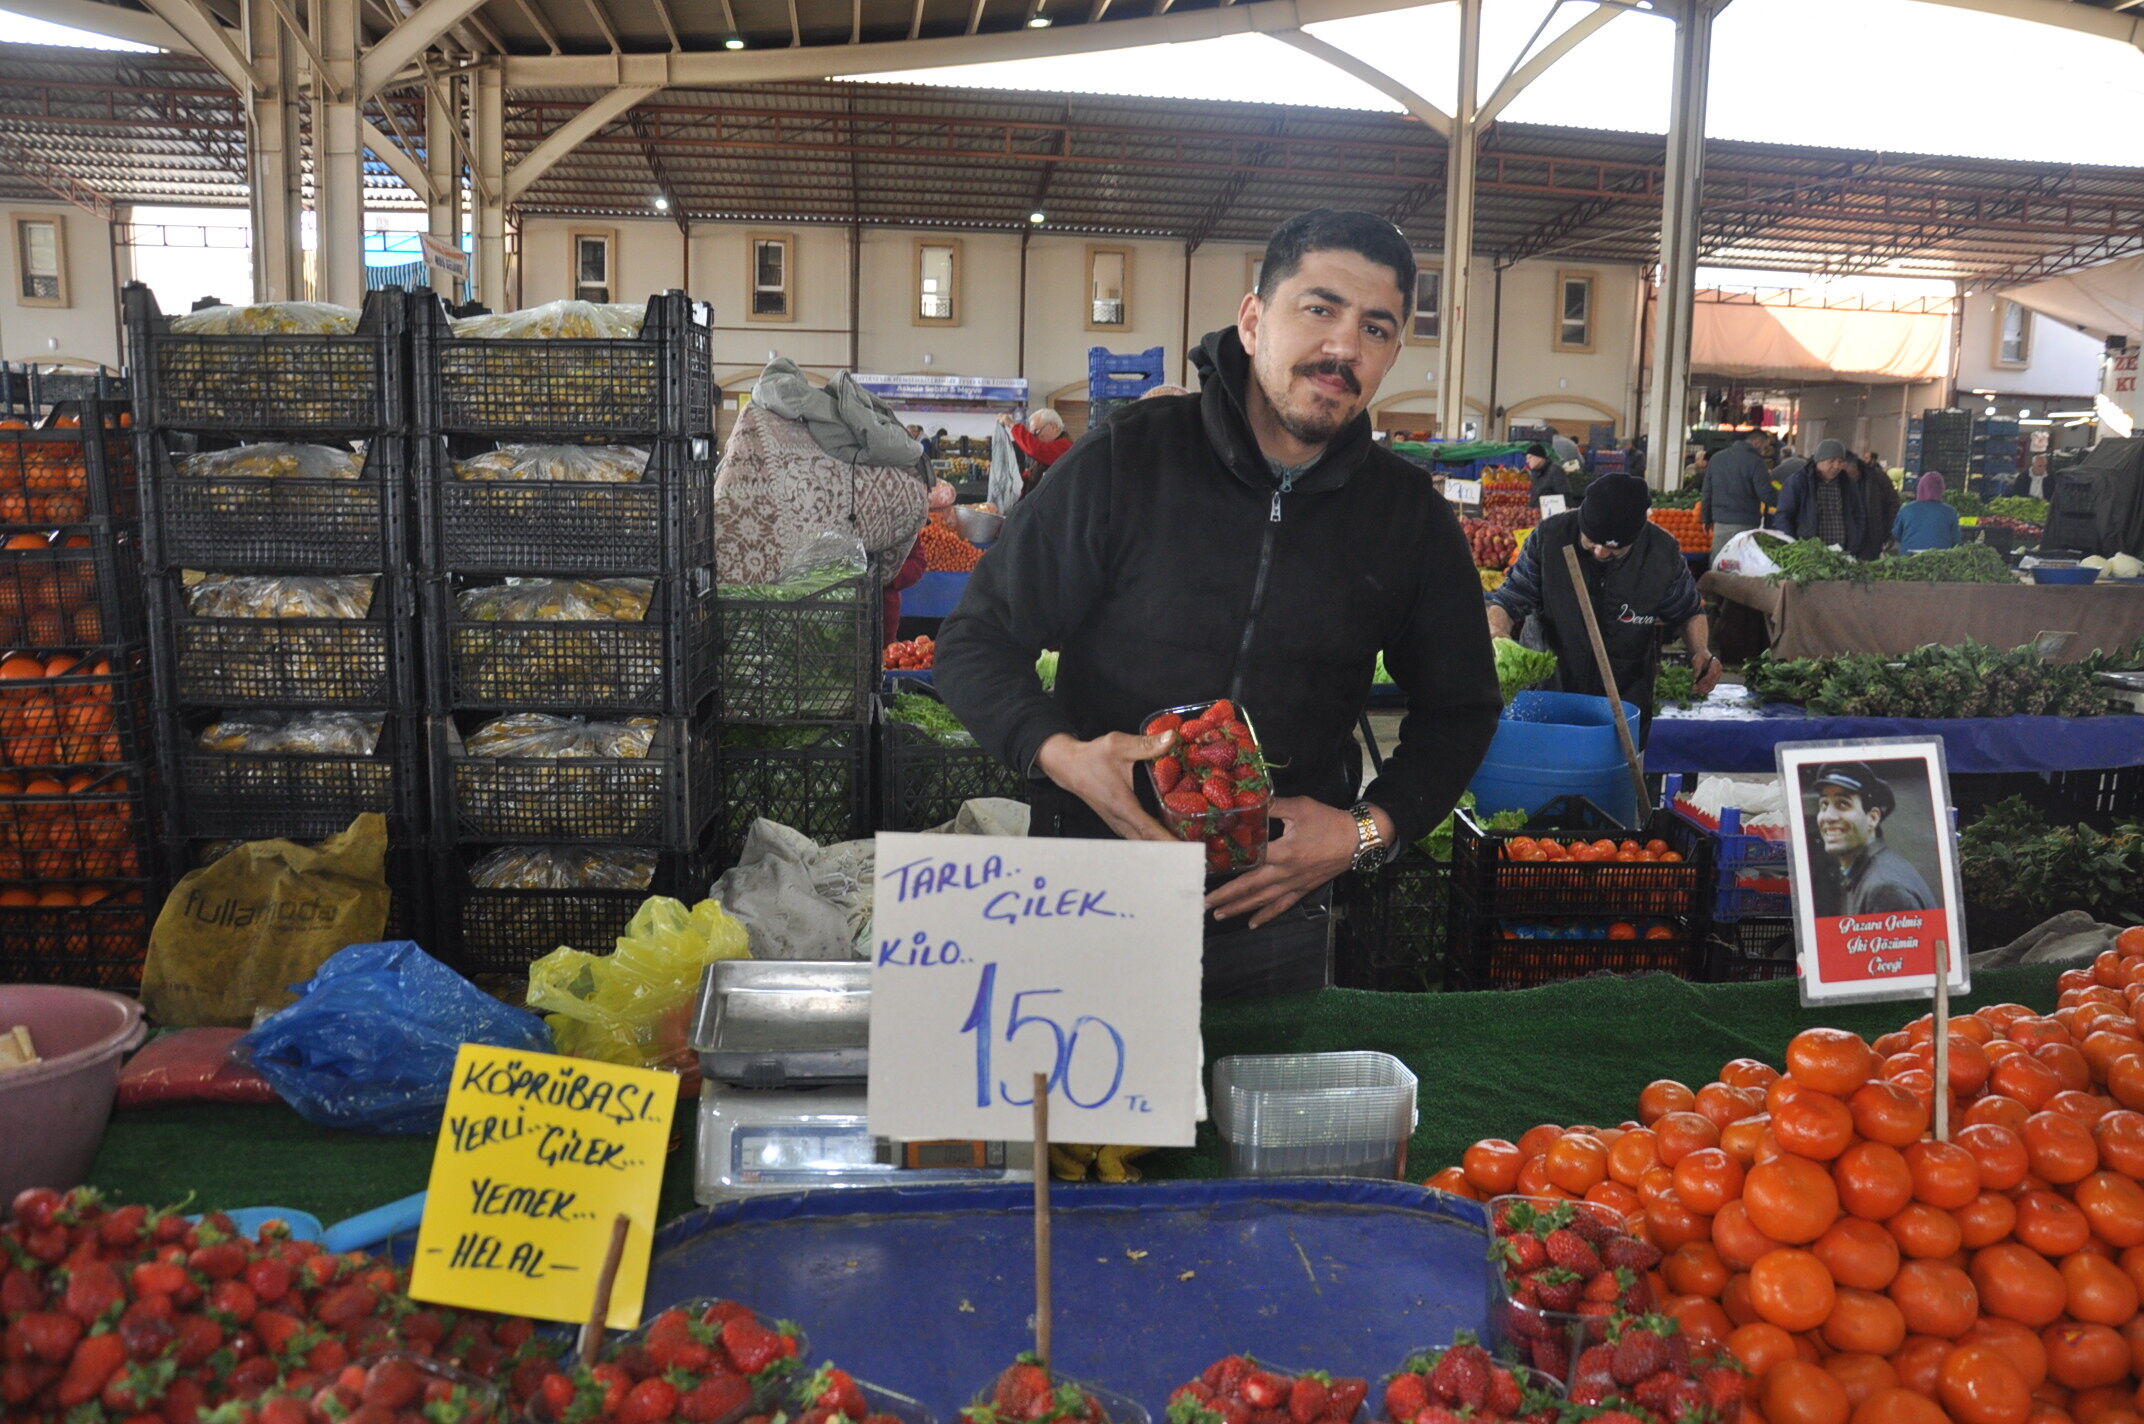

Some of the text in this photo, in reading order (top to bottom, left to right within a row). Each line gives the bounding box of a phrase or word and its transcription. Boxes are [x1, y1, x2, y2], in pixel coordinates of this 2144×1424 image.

[1839, 916, 1882, 934] Pazara
[1869, 936, 1918, 953] Gözümün
[960, 962, 1152, 1112] 150 TL
